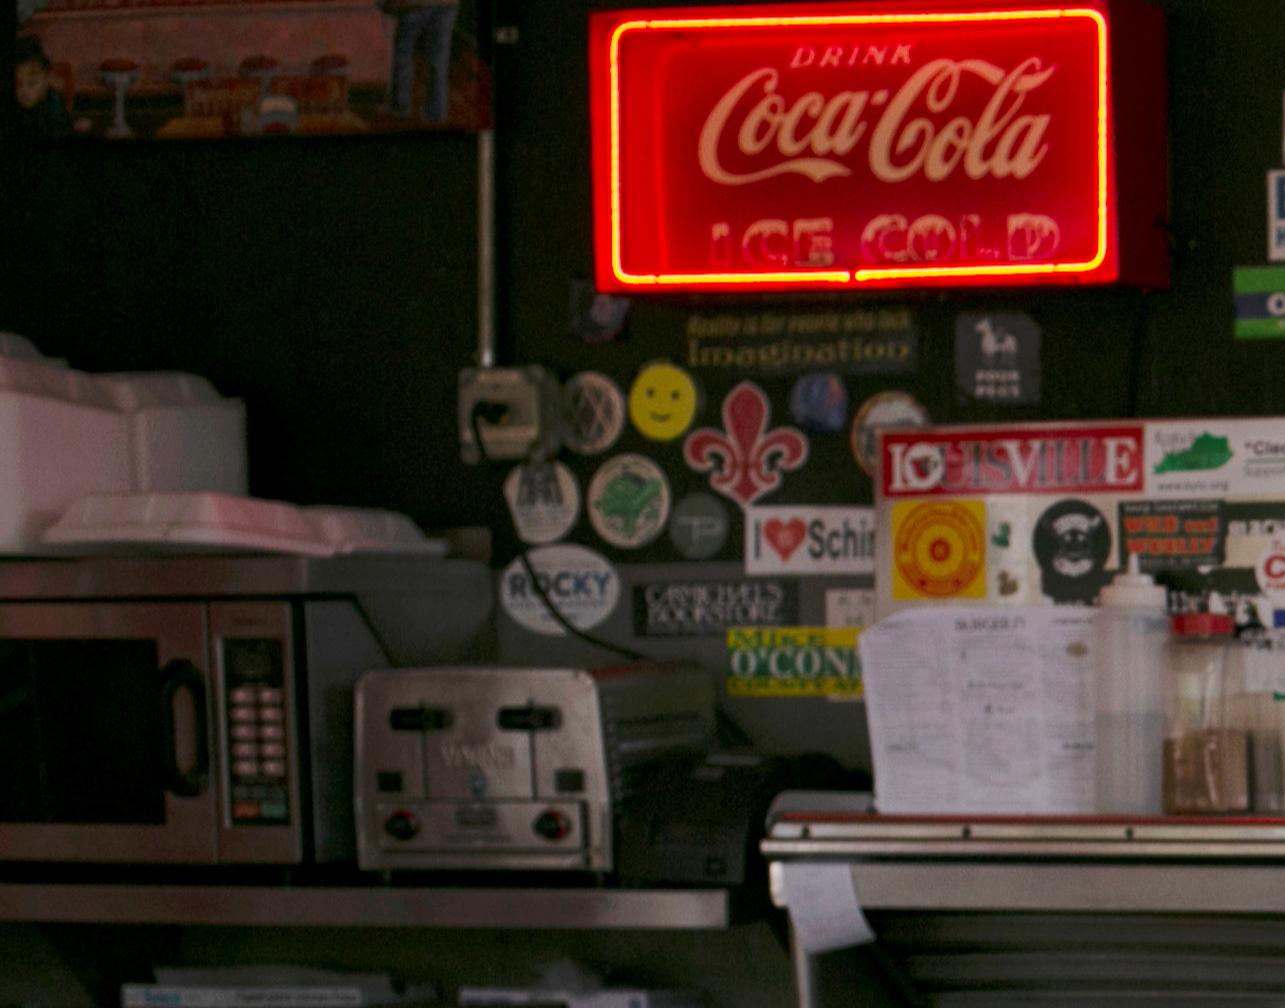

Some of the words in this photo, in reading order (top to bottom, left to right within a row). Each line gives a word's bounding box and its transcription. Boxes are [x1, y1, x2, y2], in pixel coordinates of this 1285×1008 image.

[790, 44, 912, 69] DRINK
[700, 57, 1058, 185] Coca-Cola
[711, 217, 834, 267] ICE
[861, 213, 1060, 262] COLD
[687, 338, 910, 369] Imagination
[887, 437, 1139, 494] LOUISVILLE
[509, 568, 612, 598] ROCKY
